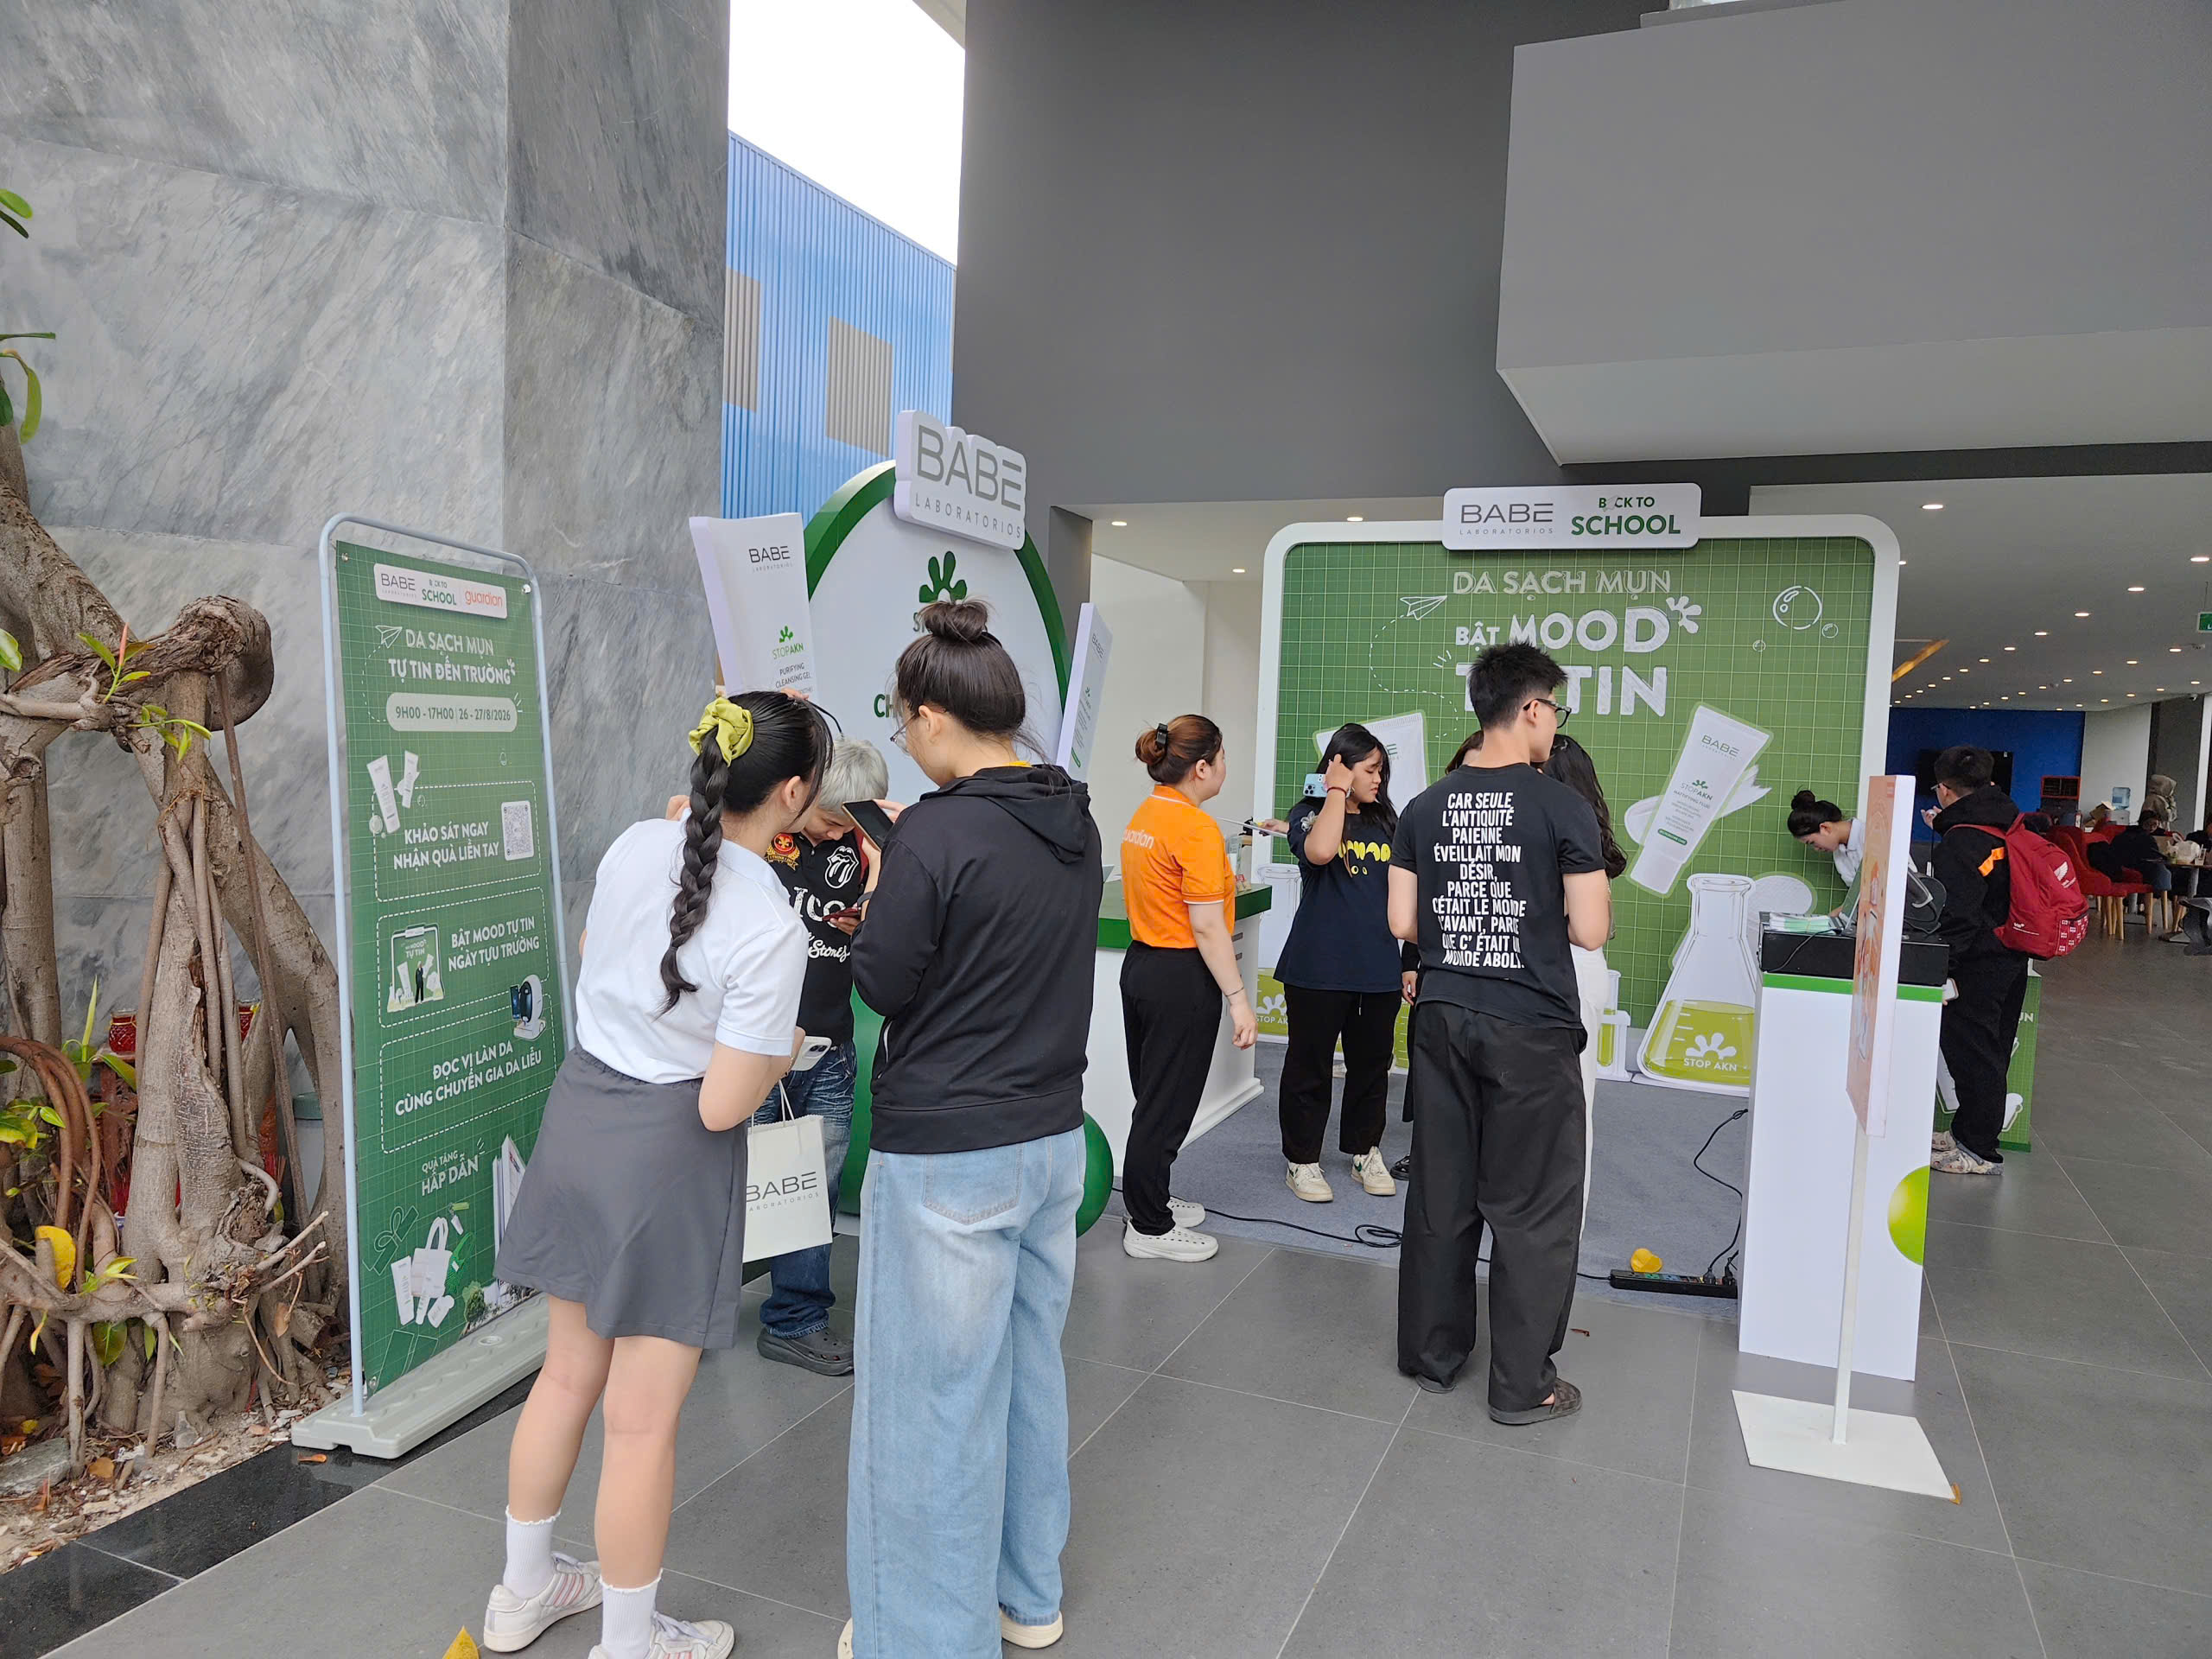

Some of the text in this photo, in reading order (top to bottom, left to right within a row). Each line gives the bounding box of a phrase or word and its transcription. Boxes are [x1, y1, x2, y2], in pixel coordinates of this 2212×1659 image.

[918, 425, 1021, 511] BABE
[1637, 497, 1655, 507] TO
[916, 493, 1021, 538] LABORATORIOS
[1460, 503, 1554, 524] BABE
[1571, 514, 1681, 536] SCHOOL
[748, 545, 791, 563] BABE
[381, 573, 416, 591] BABE
[429, 579, 441, 588] BCK
[1452, 570, 1671, 601] DA SẠCH MỤN
[422, 588, 457, 606] SCHOOL
[465, 589, 503, 607] guardian
[1455, 607, 1670, 653] BẬT MOOD
[405, 629, 494, 659] DA SẠCH MỤN
[772, 642, 804, 660] STOPAKN
[388, 655, 512, 685] TỰ TIN ĐẾN TRƯỜNG
[779, 662, 805, 677] PURIFYING
[775, 673, 803, 689] CLEANSING
[1558, 665, 1668, 717] TIN
[396, 706, 421, 719] 9H00
[428, 707, 454, 720] 17H00
[459, 708, 468, 720] 26
[475, 709, 511, 721] 27/8/2026
[1701, 734, 1739, 757] BABE
[1447, 792, 1514, 809] CAR SEULE
[1681, 783, 1713, 800] STOPAKN
[1442, 806, 1515, 827] L'ANTIQUITÉ
[404, 821, 489, 844] KHẢO SÁT NGAY
[1122, 830, 1154, 850] uardian
[1452, 827, 1503, 844] PAIENNE
[393, 838, 499, 871] NHẬN QUÀ LIỀN TAY
[1433, 842, 1521, 862] ÉVEILLAIT MON
[1459, 860, 1497, 882] DÉSIR,
[1447, 881, 1512, 899] PARCE QUE
[1474, 899, 1489, 915] LE
[451, 916, 535, 950] BẬT MOOD TỰ TIN
[1476, 932, 1510, 951] ÉTAIT
[448, 936, 540, 972] NGÀY TỰU TRƯỜNG
[1483, 952, 1525, 969] ABOLI.
[433, 1039, 513, 1080] ĐỌC VỊ LÀN DA
[1684, 1058, 1737, 1071] STOP AKN
[395, 1090, 432, 1116] CÙNG
[435, 1071, 483, 1102] CHUYÊN
[486, 1065, 504, 1083] GIA
[506, 1058, 520, 1076] DA
[439, 1150, 458, 1166] TẶNG
[422, 1168, 446, 1197] HẤP
[448, 1153, 479, 1184] DẪN
[747, 1171, 817, 1202] BABE
[749, 1192, 818, 1211] ABORATORIOS
